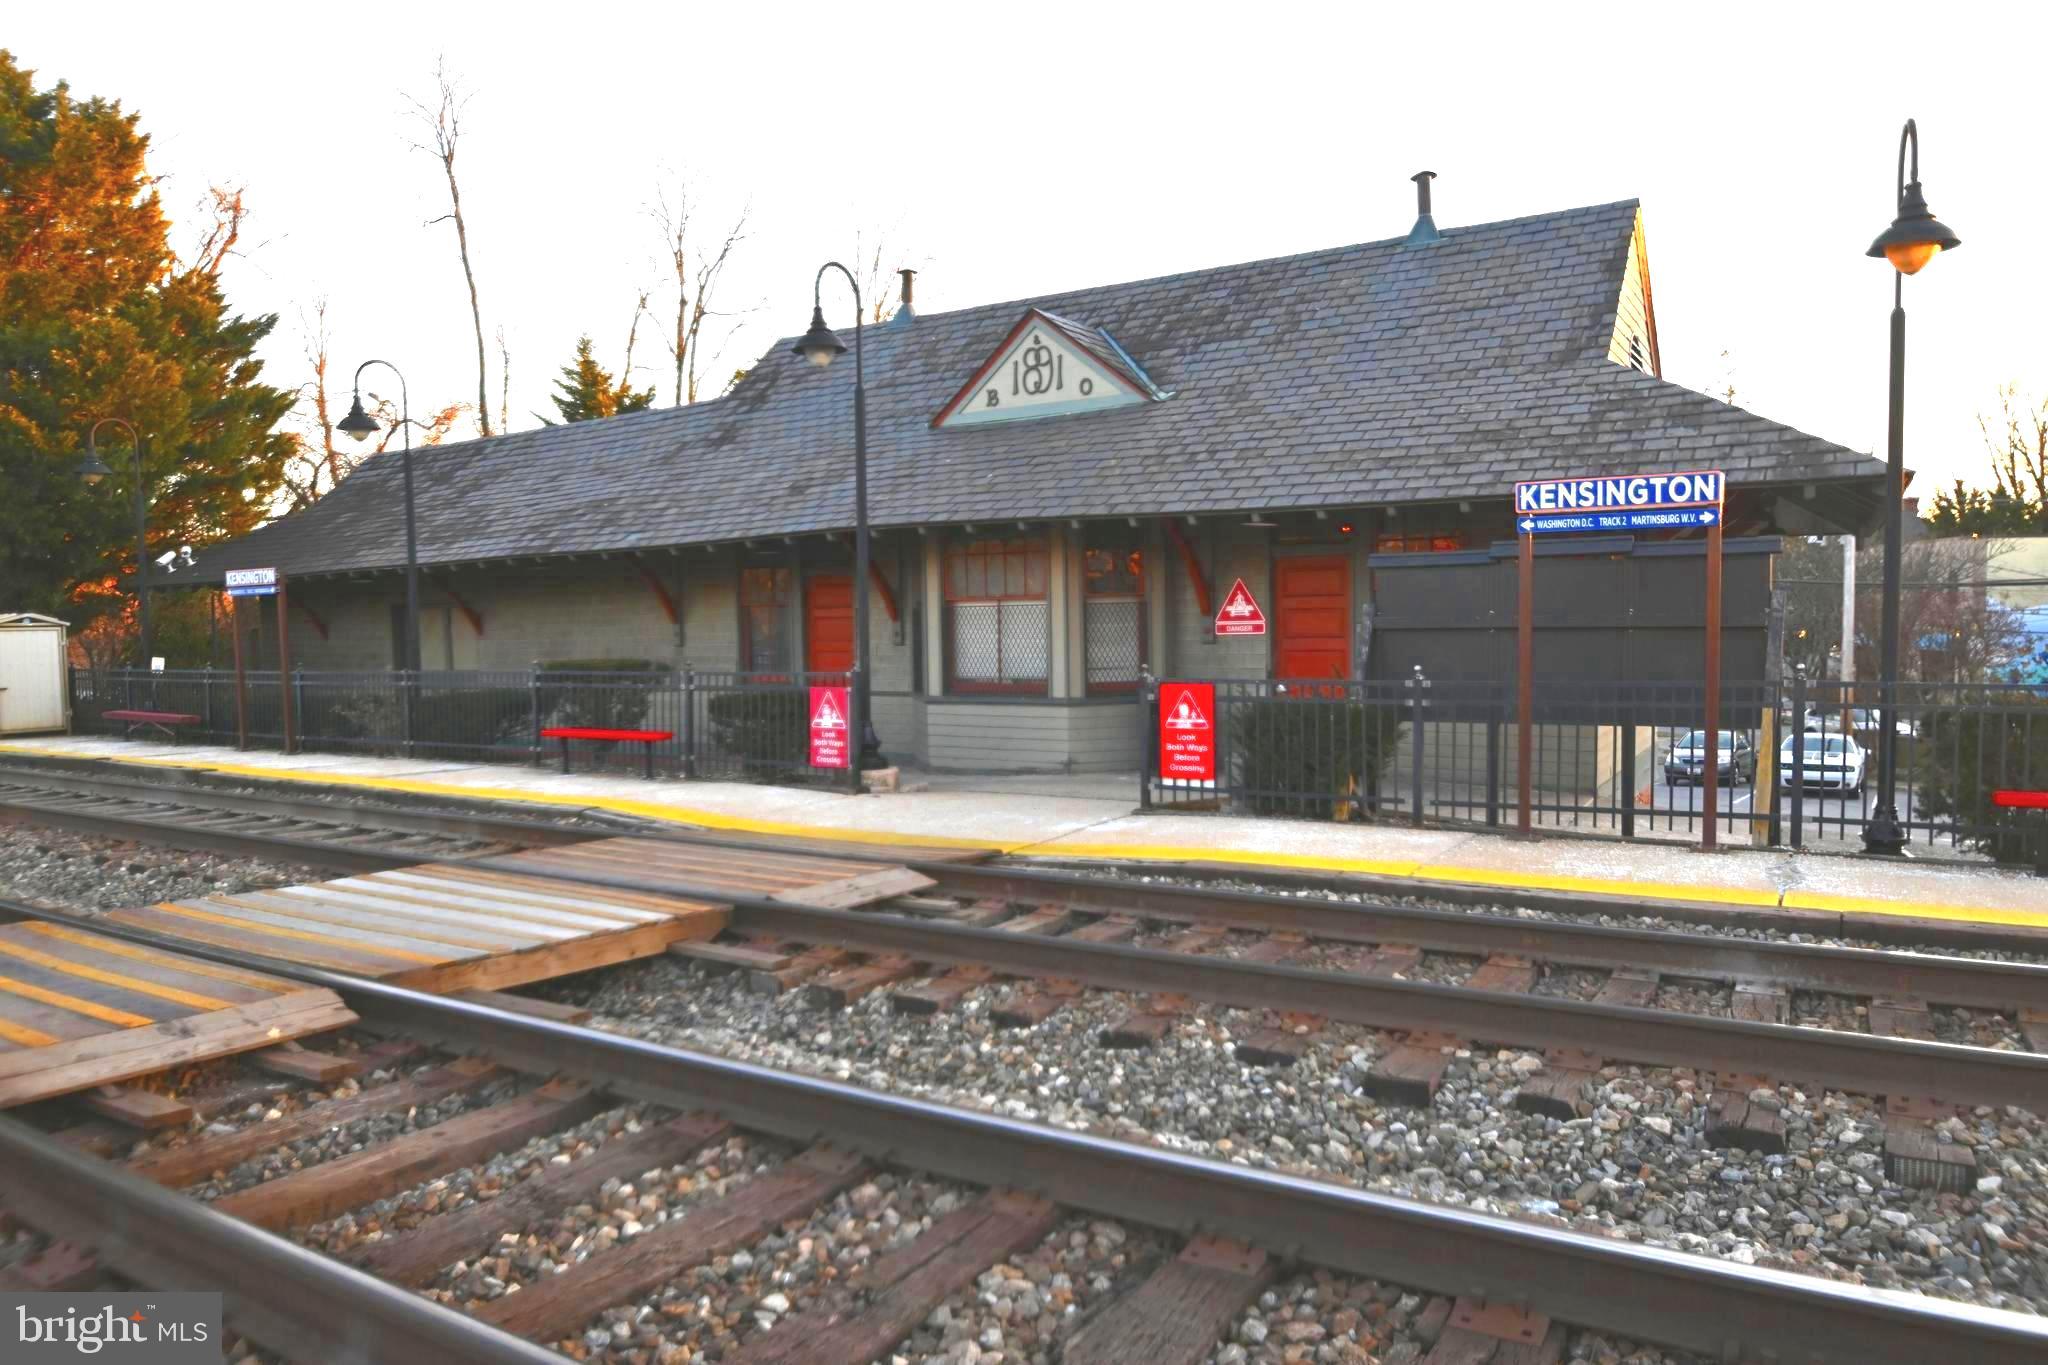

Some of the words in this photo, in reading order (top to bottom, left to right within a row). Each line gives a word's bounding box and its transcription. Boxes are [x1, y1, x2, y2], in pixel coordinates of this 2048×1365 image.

[986, 388, 999, 407] B
[1012, 345, 1063, 396] 1891
[1519, 475, 1715, 510] KENSINGTON
[1537, 518, 1580, 528] WASHINGTON
[1581, 518, 1594, 527] D.C.
[1599, 517, 1621, 526] TRACK
[1631, 514, 1679, 525] MARTINSBURG
[1681, 513, 1696, 523] W.V.
[226, 570, 275, 585] KENSINGTON
[1166, 743, 1185, 751] Both
[1186, 744, 1208, 752] Ways
[1169, 763, 1205, 773] Crossing
